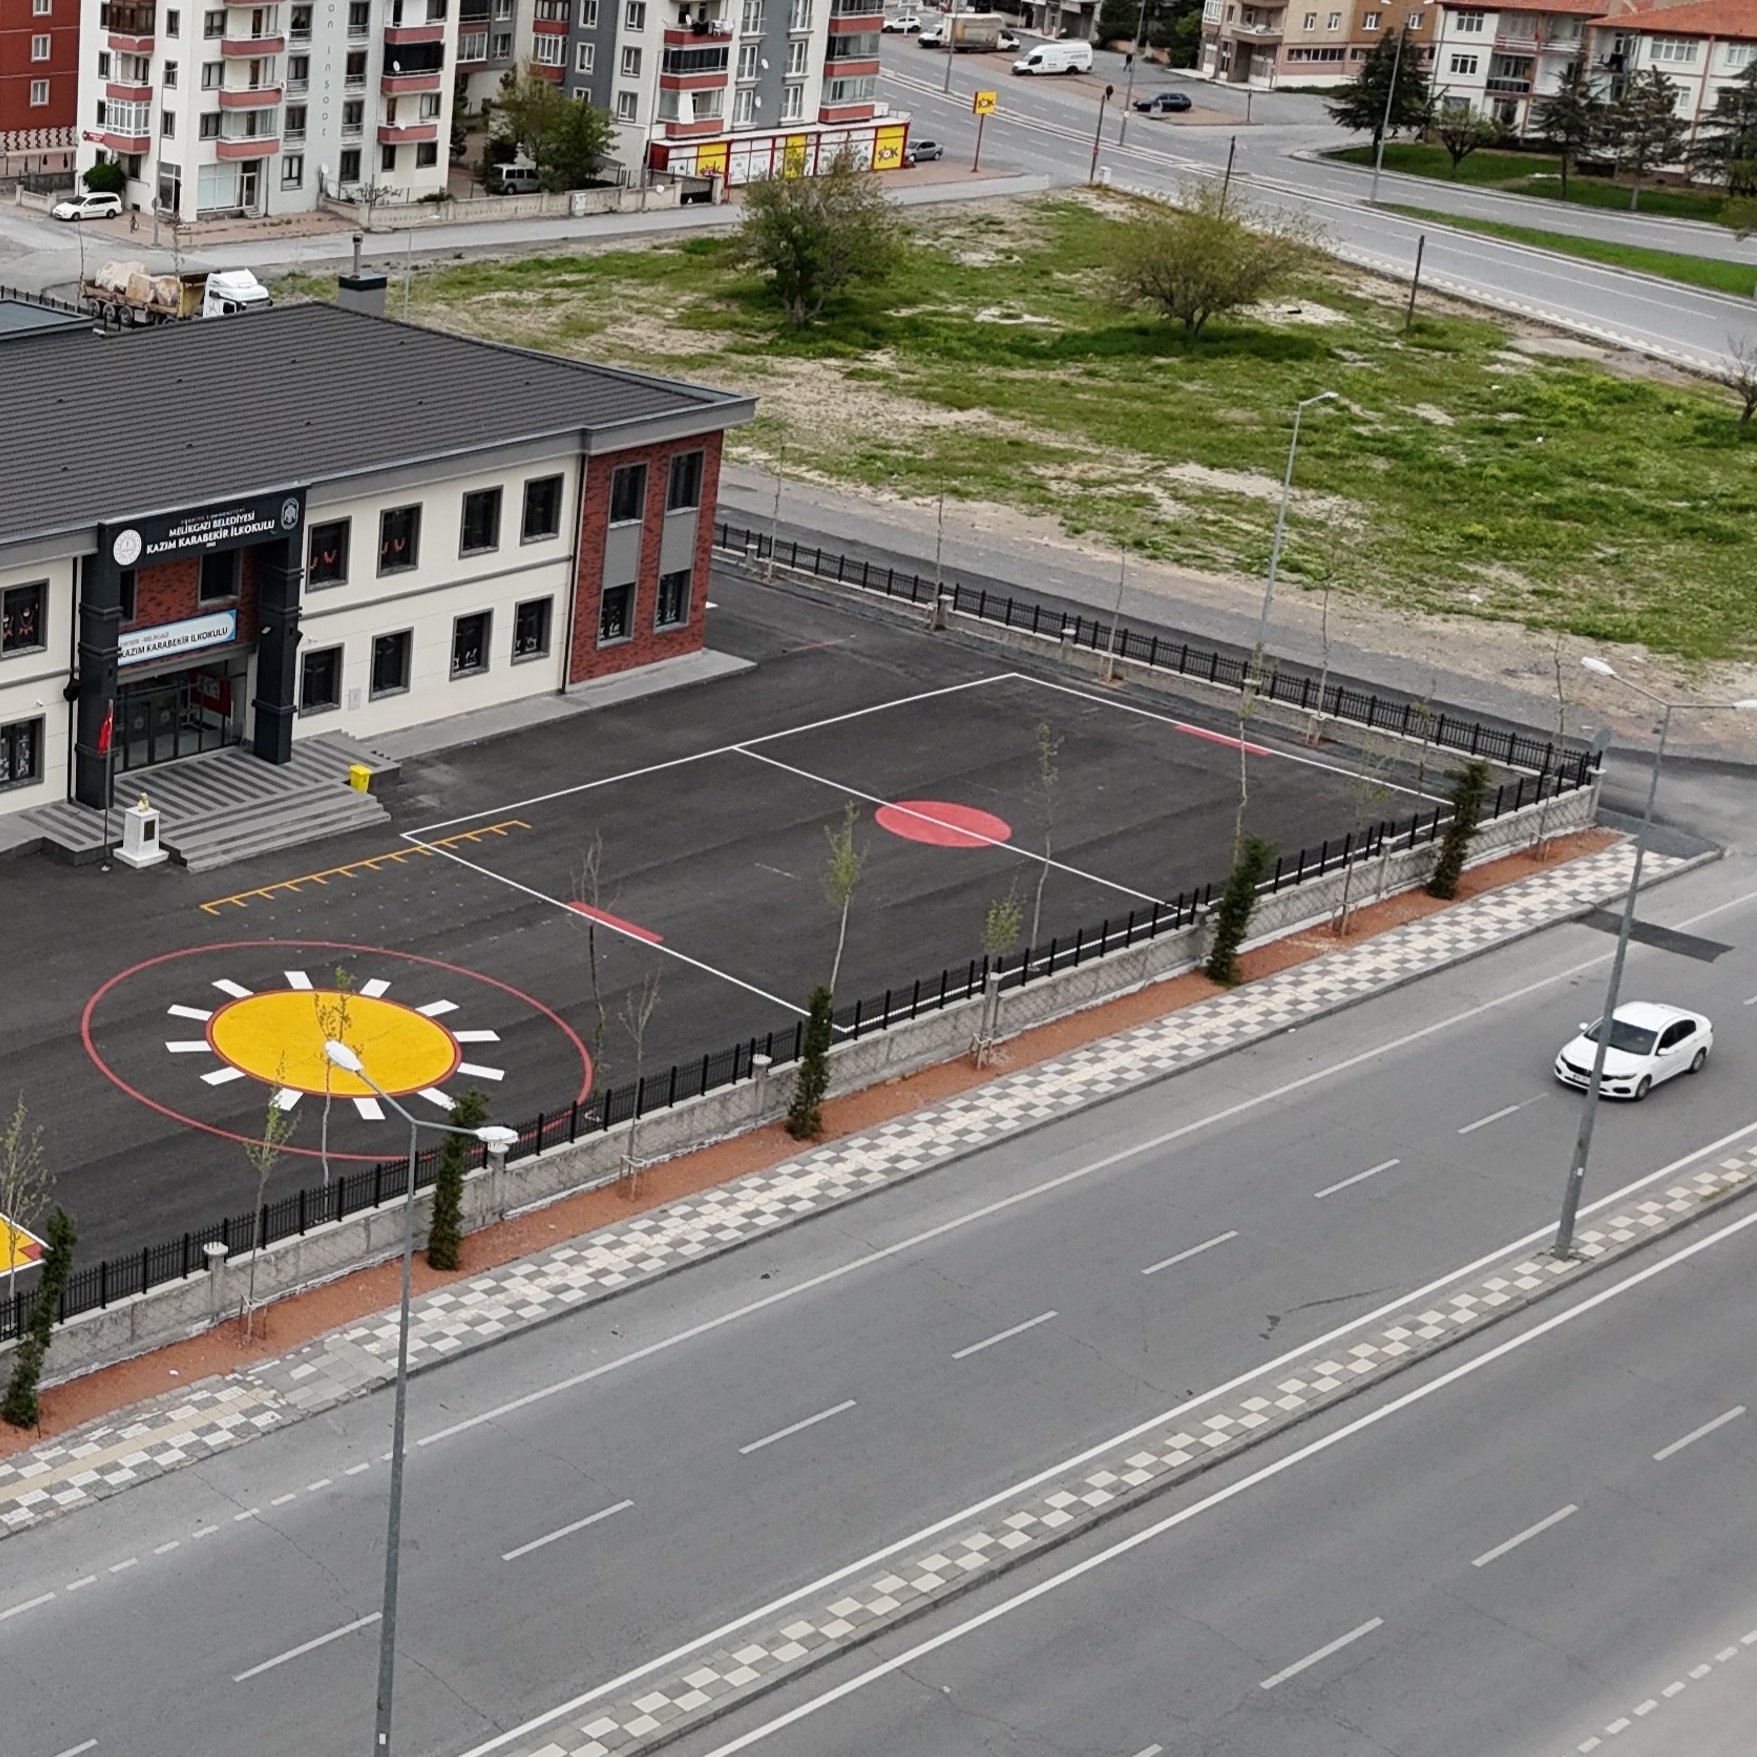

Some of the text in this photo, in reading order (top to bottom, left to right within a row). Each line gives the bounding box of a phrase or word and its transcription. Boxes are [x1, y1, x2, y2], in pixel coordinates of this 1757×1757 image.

[212, 510, 255, 528] BELEDİYESİ
[146, 519, 276, 554] KAZIM KARABEKİR İLKOKULU
[147, 636, 189, 652] KARABEKİR
